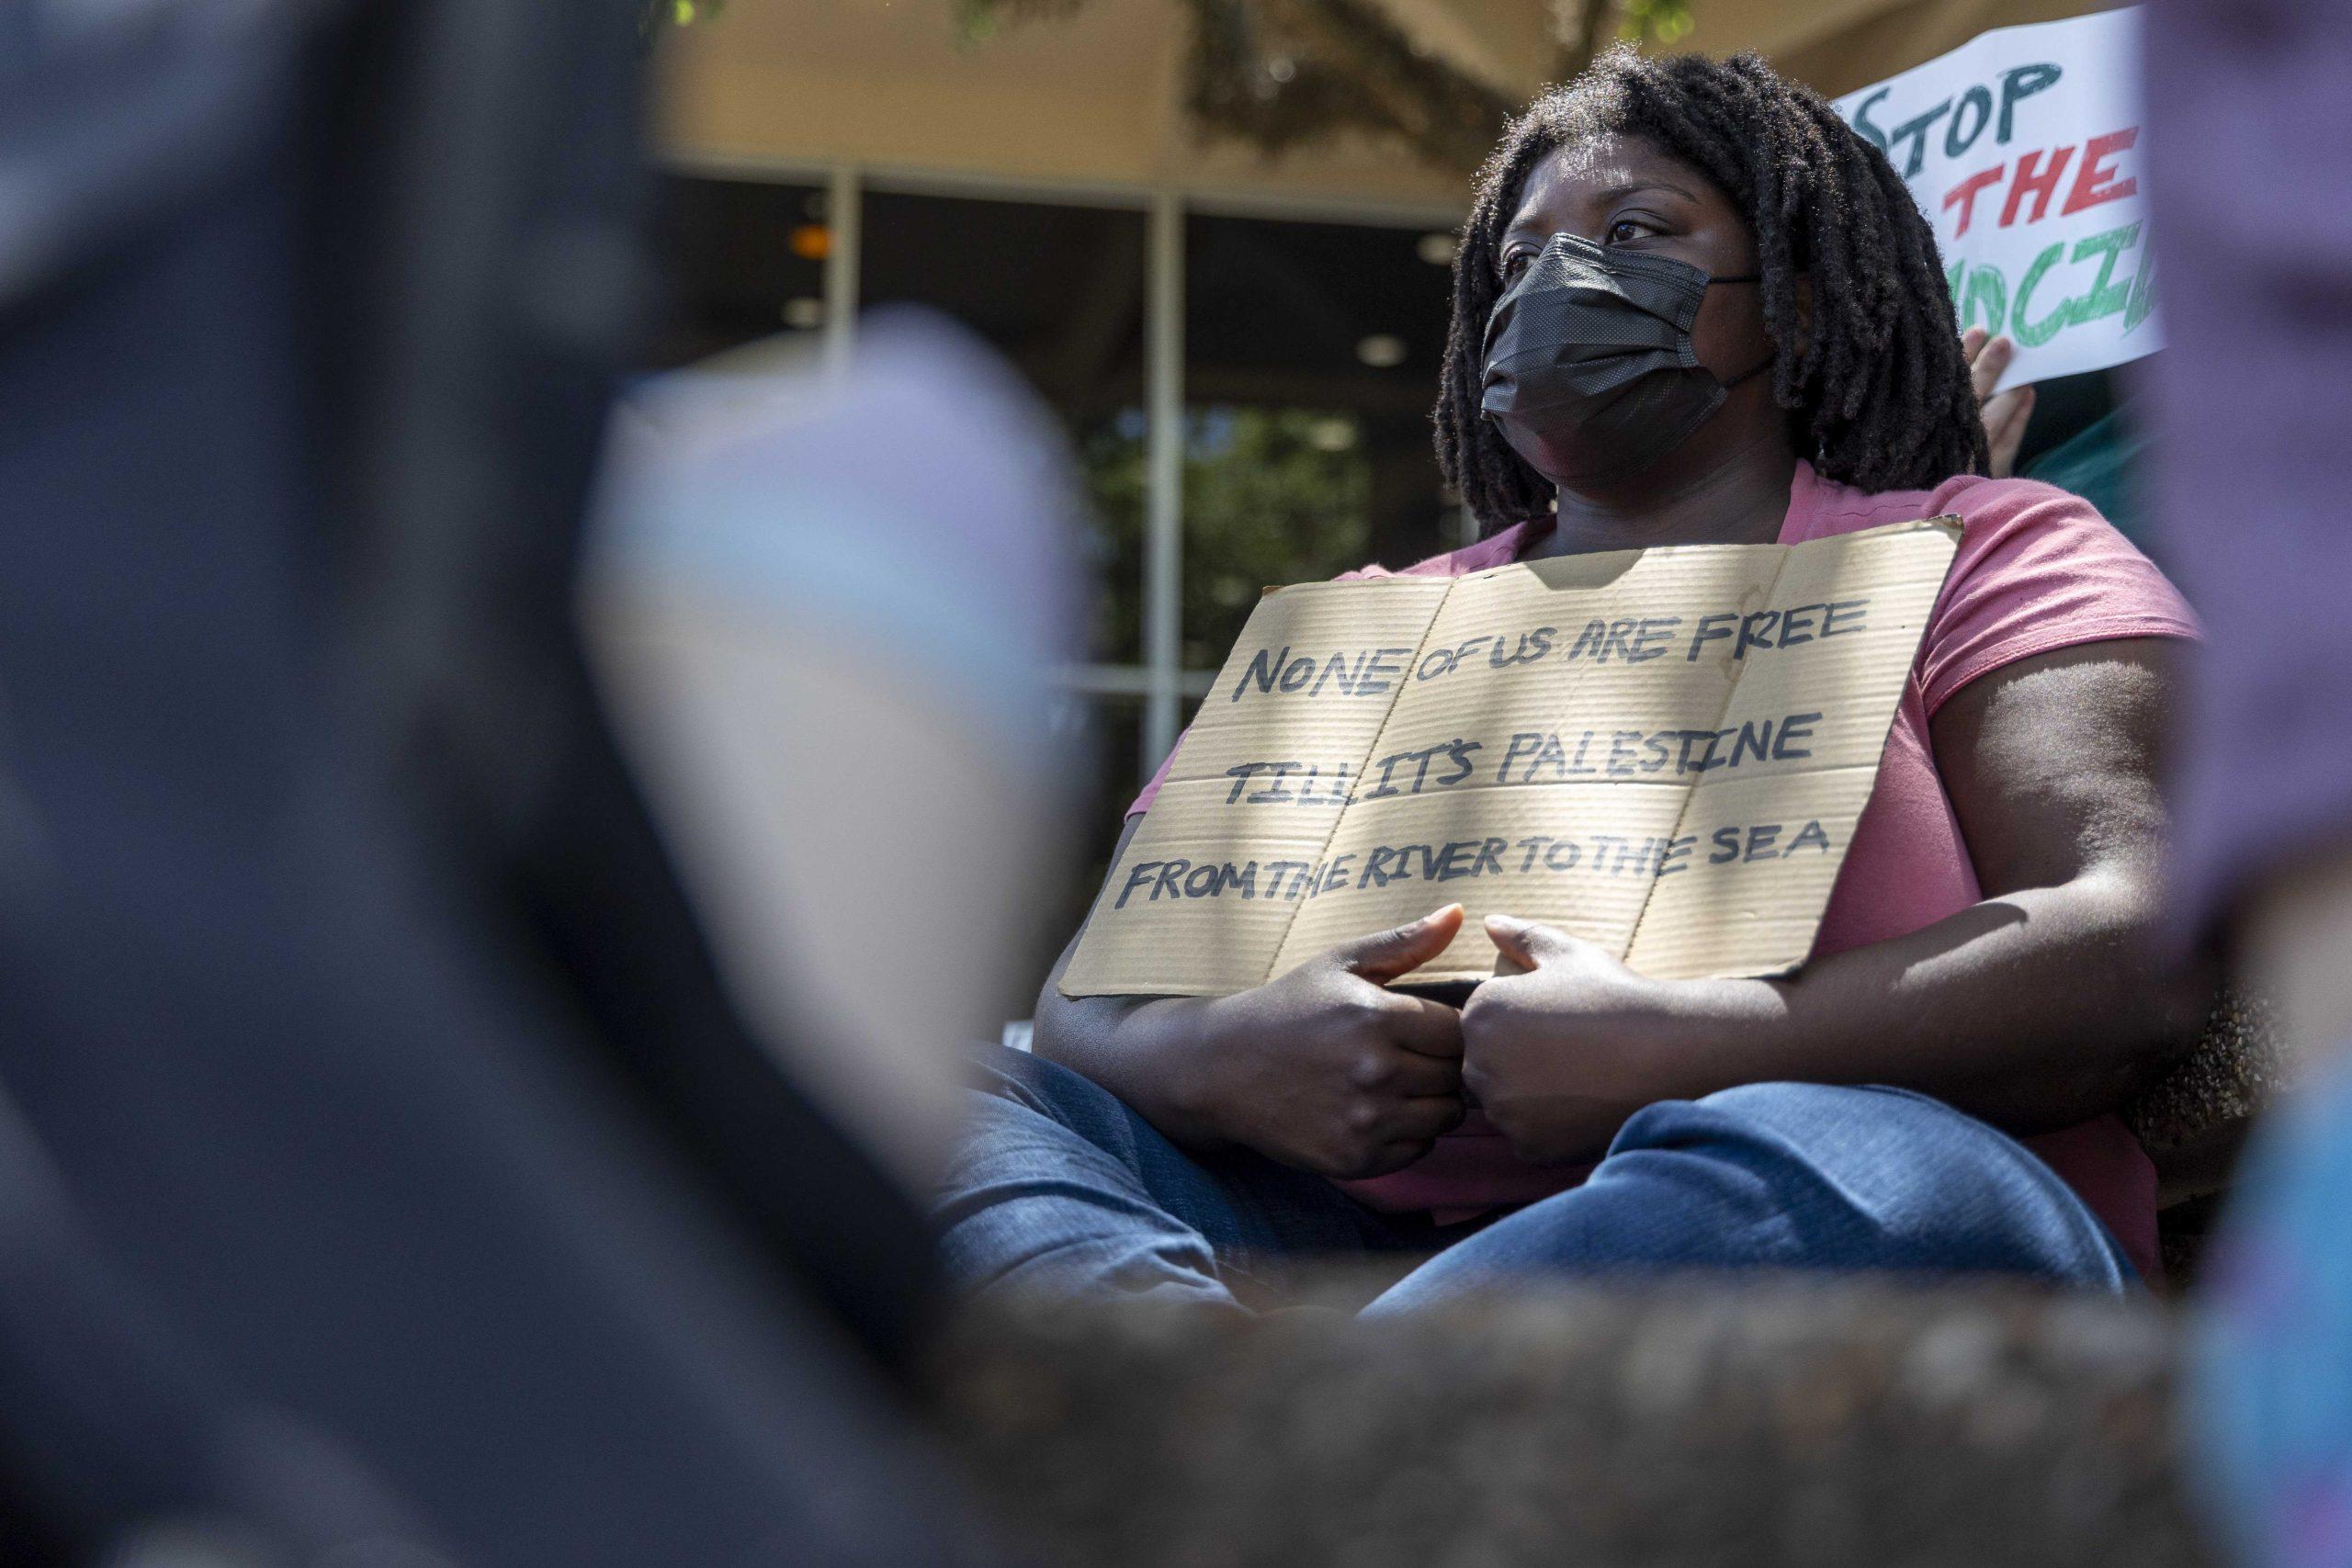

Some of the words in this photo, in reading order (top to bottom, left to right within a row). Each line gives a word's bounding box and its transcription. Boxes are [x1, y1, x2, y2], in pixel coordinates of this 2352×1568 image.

[1853, 62, 2063, 180] STOP
[1942, 126, 2139, 241] THE
[1231, 646, 1413, 703] NONE
[1417, 635, 1492, 682] OF
[1488, 626, 1557, 669] US
[1567, 616, 1682, 664] ARE
[1687, 599, 1871, 661] FREE
[1226, 761, 1358, 806] TILL
[1497, 712, 1823, 784] PALESTINE
[1114, 858, 1257, 910] FROM
[1262, 853, 1357, 901] THE
[1358, 837, 1508, 889] RIVER
[1515, 836, 1581, 873] TO
[1589, 834, 1697, 877] THE
[1708, 820, 1830, 866] SEA
